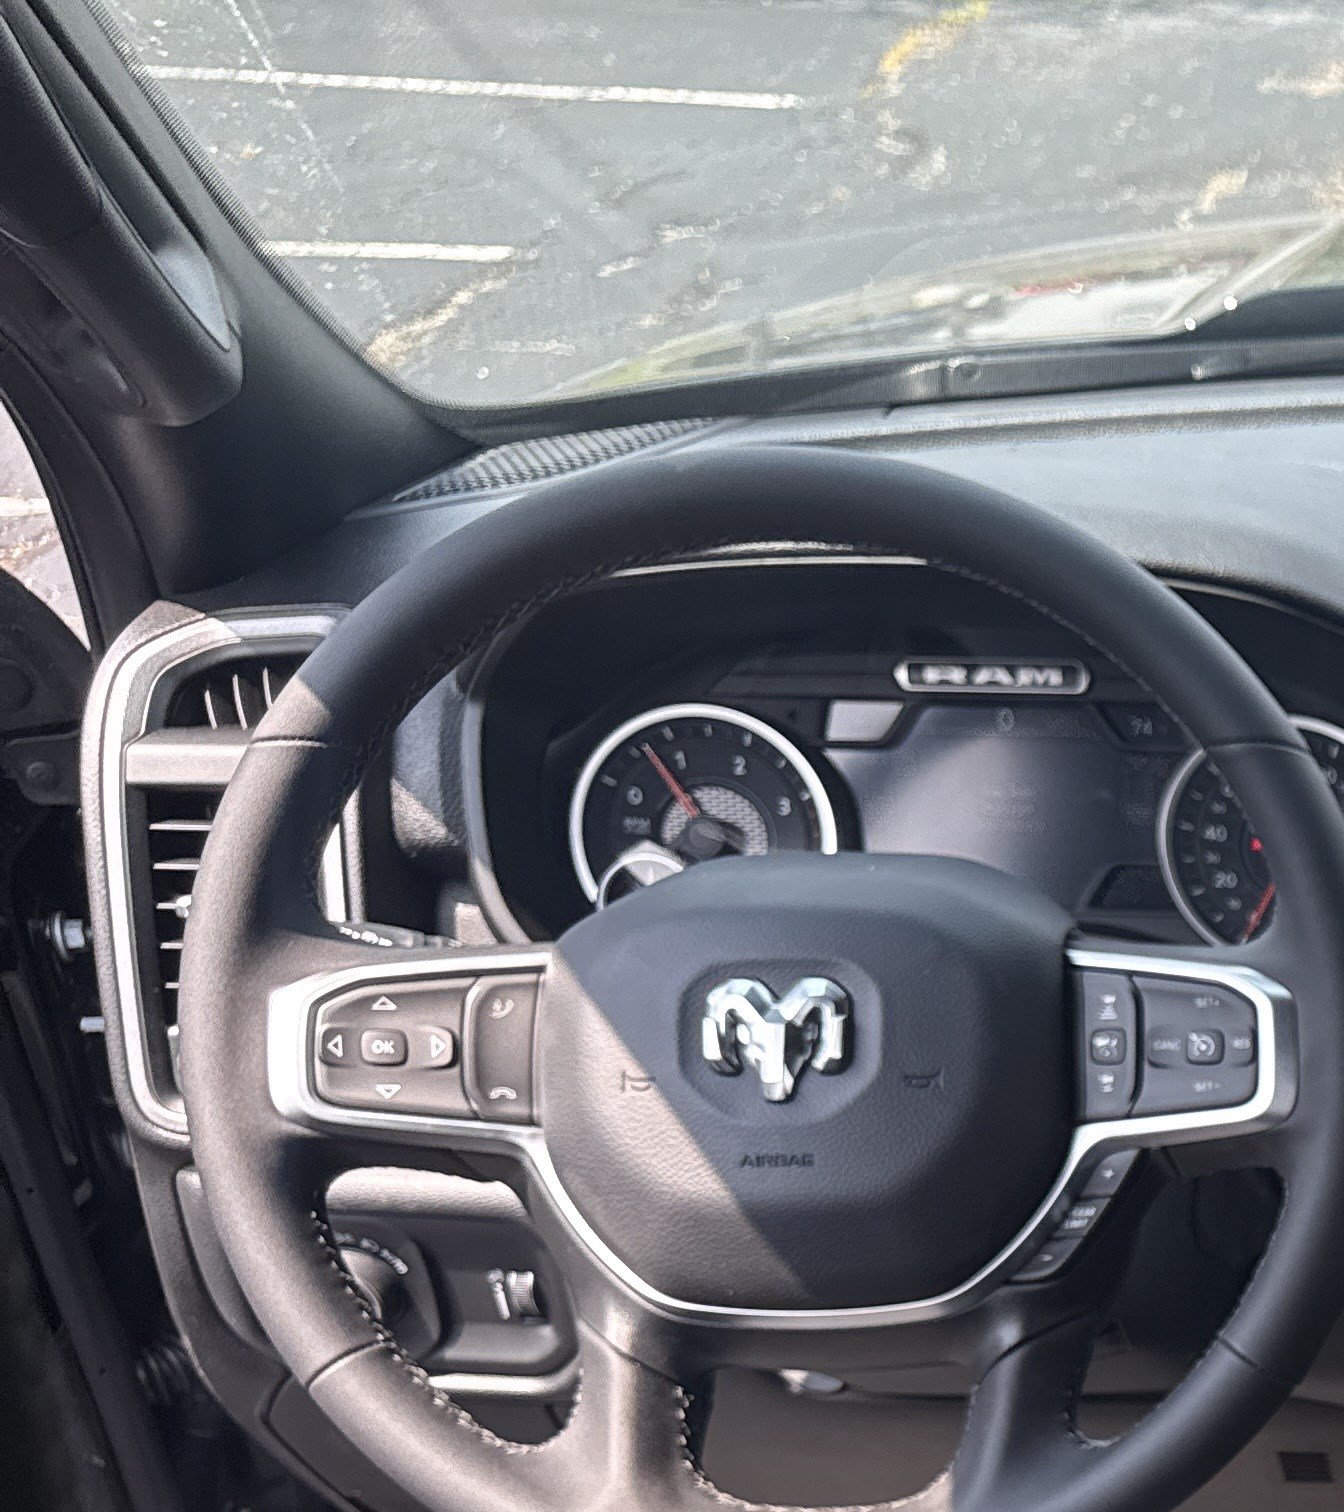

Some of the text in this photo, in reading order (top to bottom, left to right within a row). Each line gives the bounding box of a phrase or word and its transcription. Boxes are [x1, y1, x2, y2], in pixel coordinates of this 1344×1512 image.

[921, 662, 1065, 688] RAM
[732, 755, 748, 776] 2
[776, 796, 792, 817] 3
[1203, 824, 1229, 843] 40
[1213, 871, 1238, 889] 20
[371, 1039, 395, 1055] OK
[739, 1152, 816, 1168] AIRBAG
